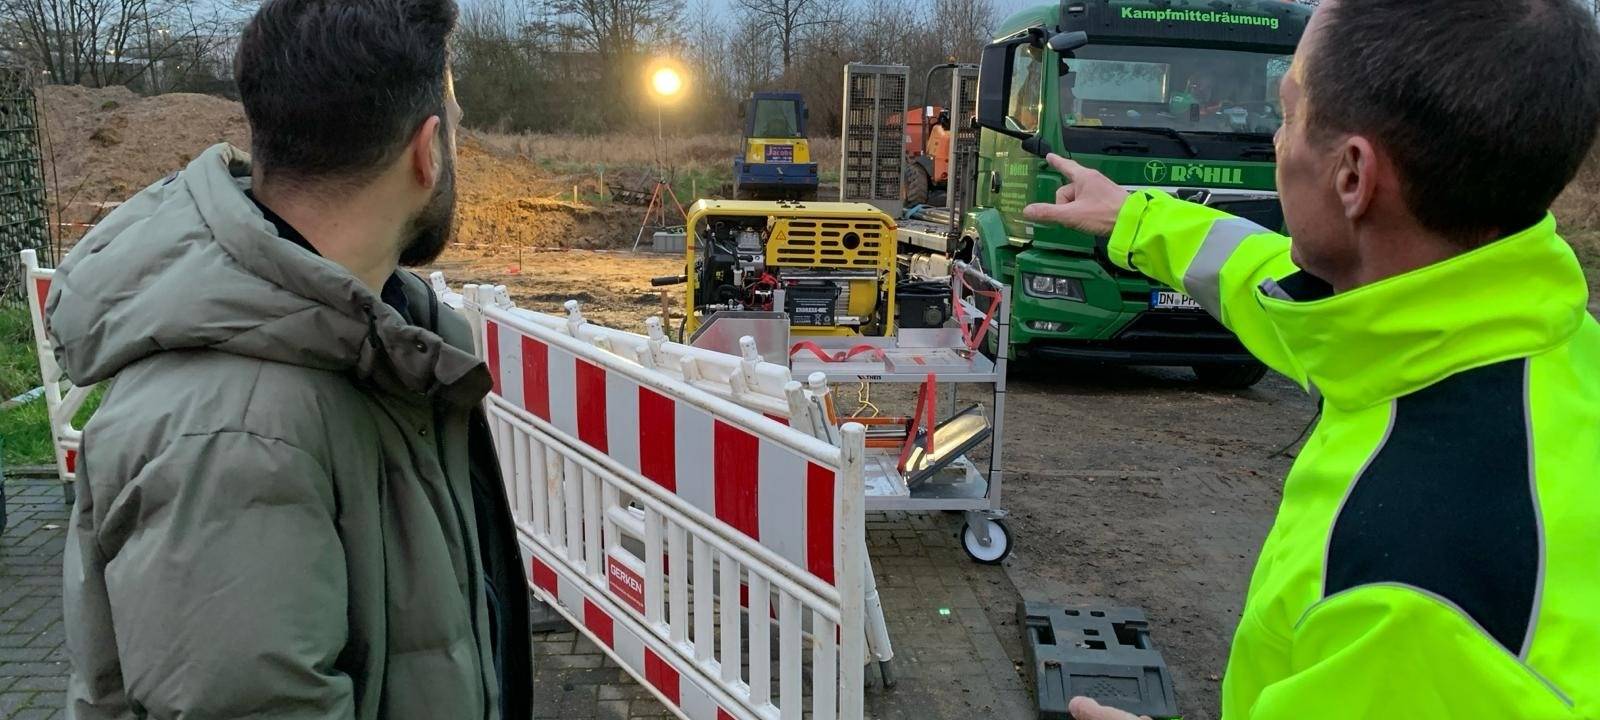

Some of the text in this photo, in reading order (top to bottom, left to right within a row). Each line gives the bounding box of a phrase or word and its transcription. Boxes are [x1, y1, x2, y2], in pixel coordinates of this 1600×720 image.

[1121, 7, 1279, 28] Kampfmittelräumung
[1171, 163, 1243, 184] RÖHLL
[1158, 293, 1174, 305] DN
[610, 563, 642, 595] GERKEN
